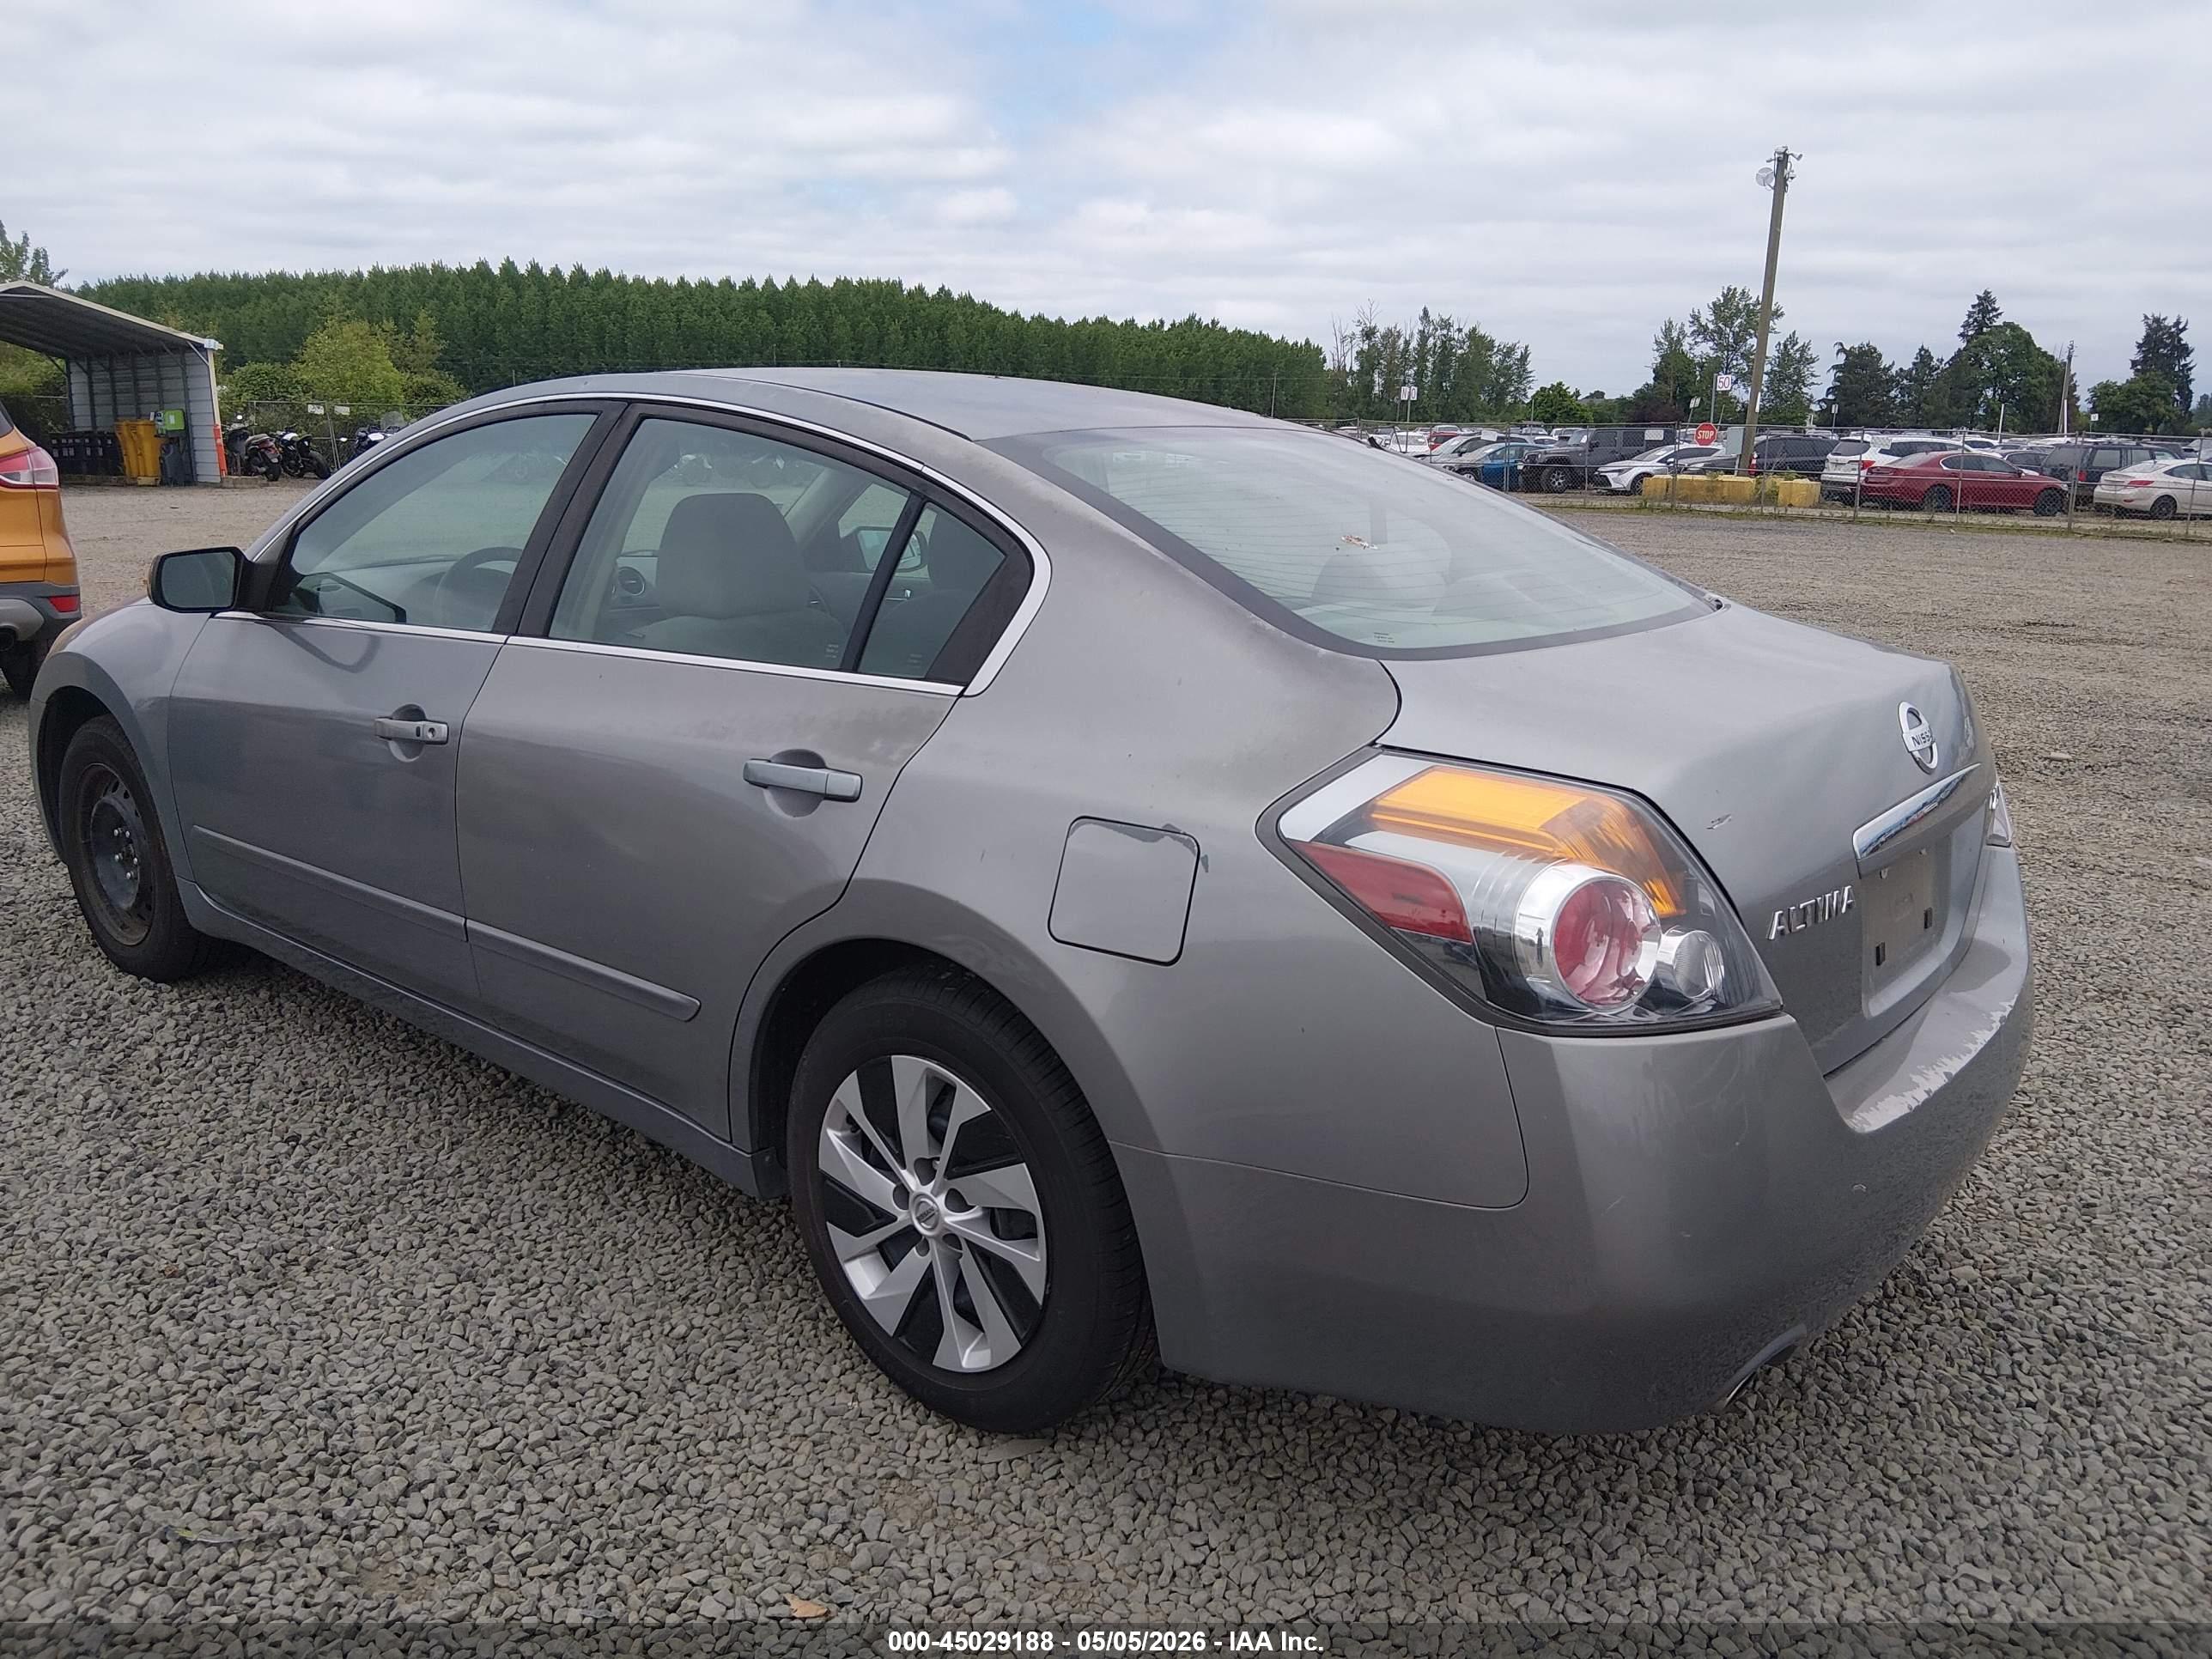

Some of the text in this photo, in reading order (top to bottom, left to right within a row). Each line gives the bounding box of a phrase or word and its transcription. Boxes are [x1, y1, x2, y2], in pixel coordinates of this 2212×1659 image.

[1718, 376, 1730, 389] 50
[1697, 430, 1715, 440] STOP
[1911, 729, 1932, 747] NISS
[1765, 885, 1855, 940] ALTIMA
